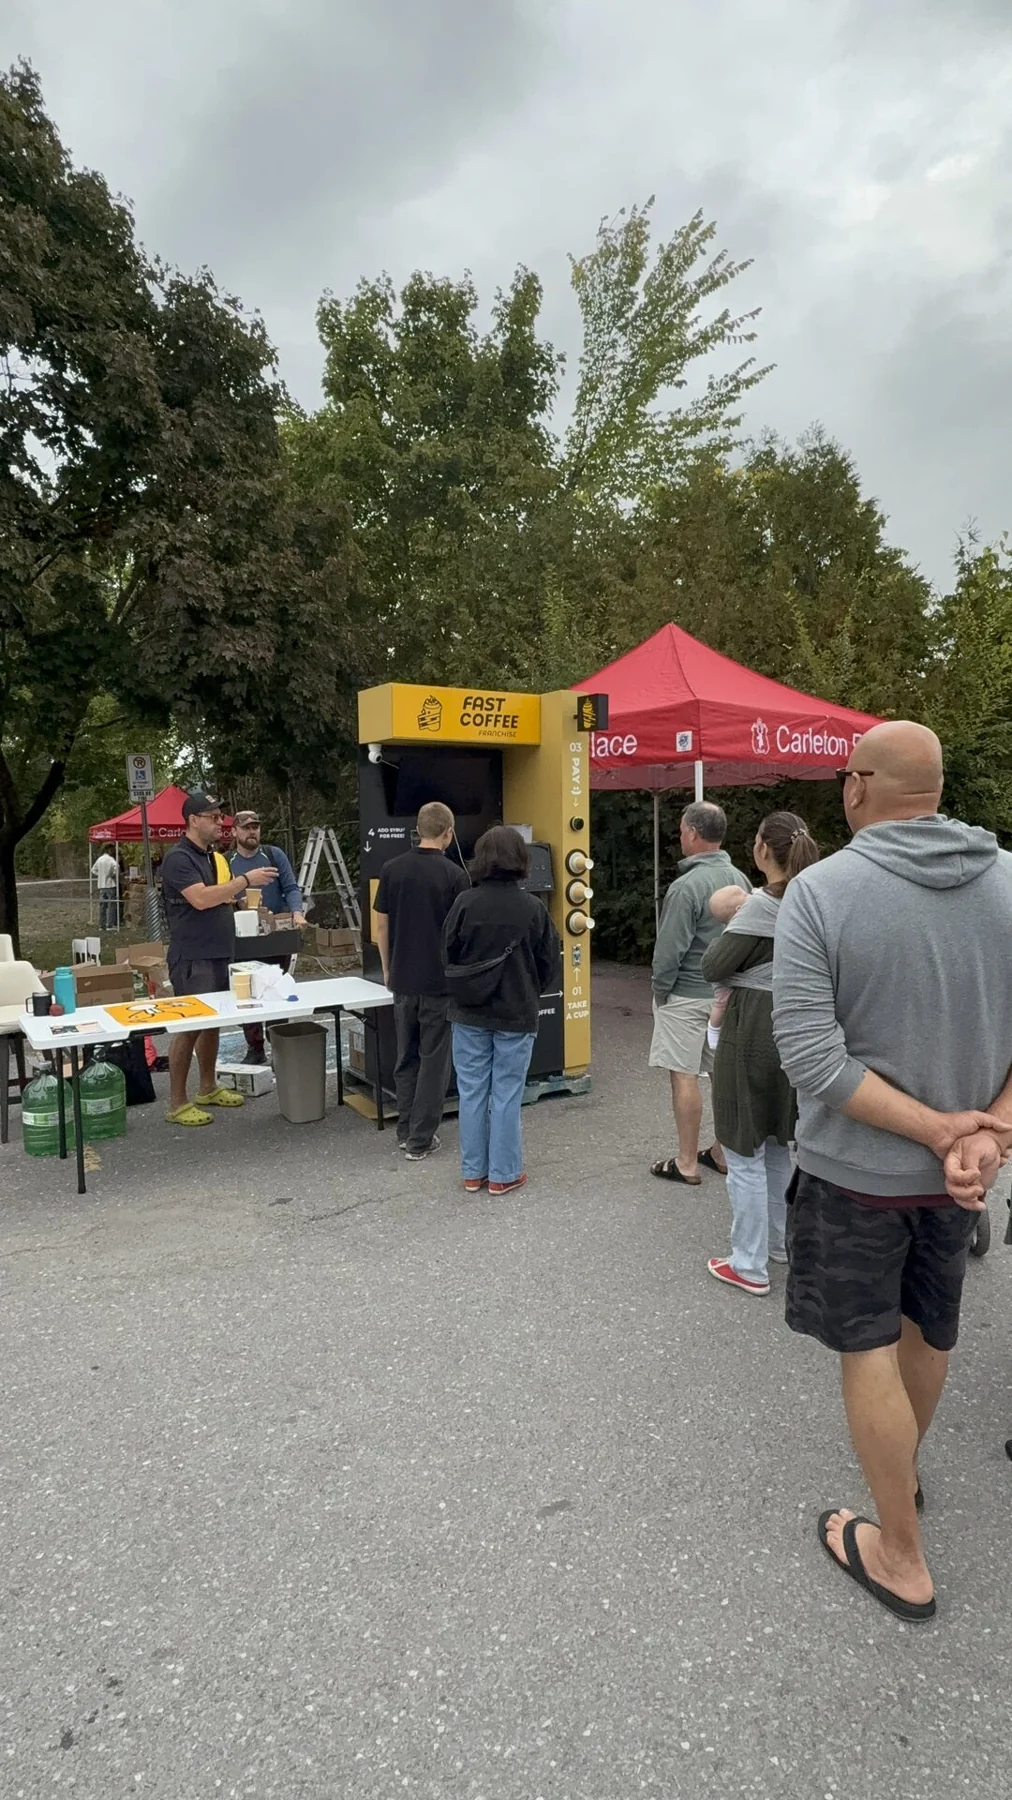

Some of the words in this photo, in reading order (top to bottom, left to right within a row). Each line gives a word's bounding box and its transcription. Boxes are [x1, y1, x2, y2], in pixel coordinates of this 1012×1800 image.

[462, 696, 506, 712] FAST
[460, 713, 519, 729] COFFEE
[478, 730, 517, 738] FRANCHISE
[591, 732, 638, 758] lace
[776, 725, 848, 756] Carleton
[569, 742, 582, 752] 03
[572, 757, 580, 784] PAY
[368, 828, 375, 837] 4
[572, 986, 582, 996] 01
[567, 1000, 587, 1010] TAKE
[573, 1010, 589, 1019] CUP
